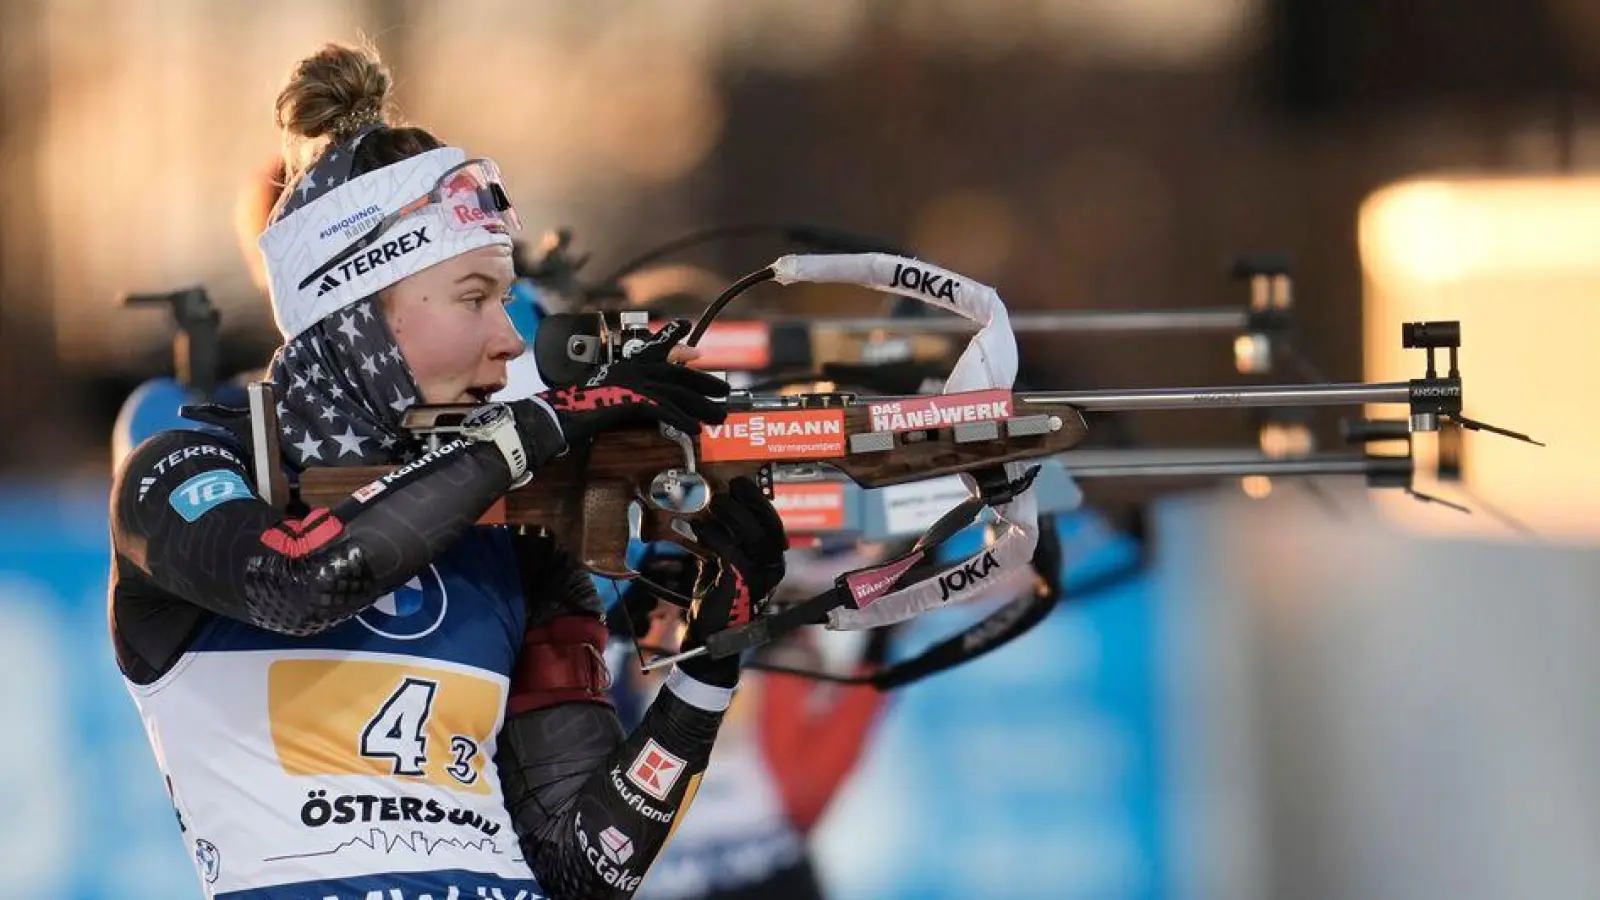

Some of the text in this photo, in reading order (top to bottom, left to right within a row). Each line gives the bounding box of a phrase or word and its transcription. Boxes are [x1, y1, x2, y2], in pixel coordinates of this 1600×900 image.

[319, 204, 382, 239] #UBIQUINOL
[338, 226, 431, 282] TERREX
[889, 263, 957, 303] JOKA
[704, 416, 840, 446] VIESSMANN
[872, 402, 902, 415] DAS
[872, 401, 1009, 432] HANDWERK
[938, 553, 1000, 602] JOKA
[360, 677, 437, 777] 4
[446, 736, 479, 785] 3
[610, 764, 675, 823] Kaufland
[574, 811, 643, 892] tectake
